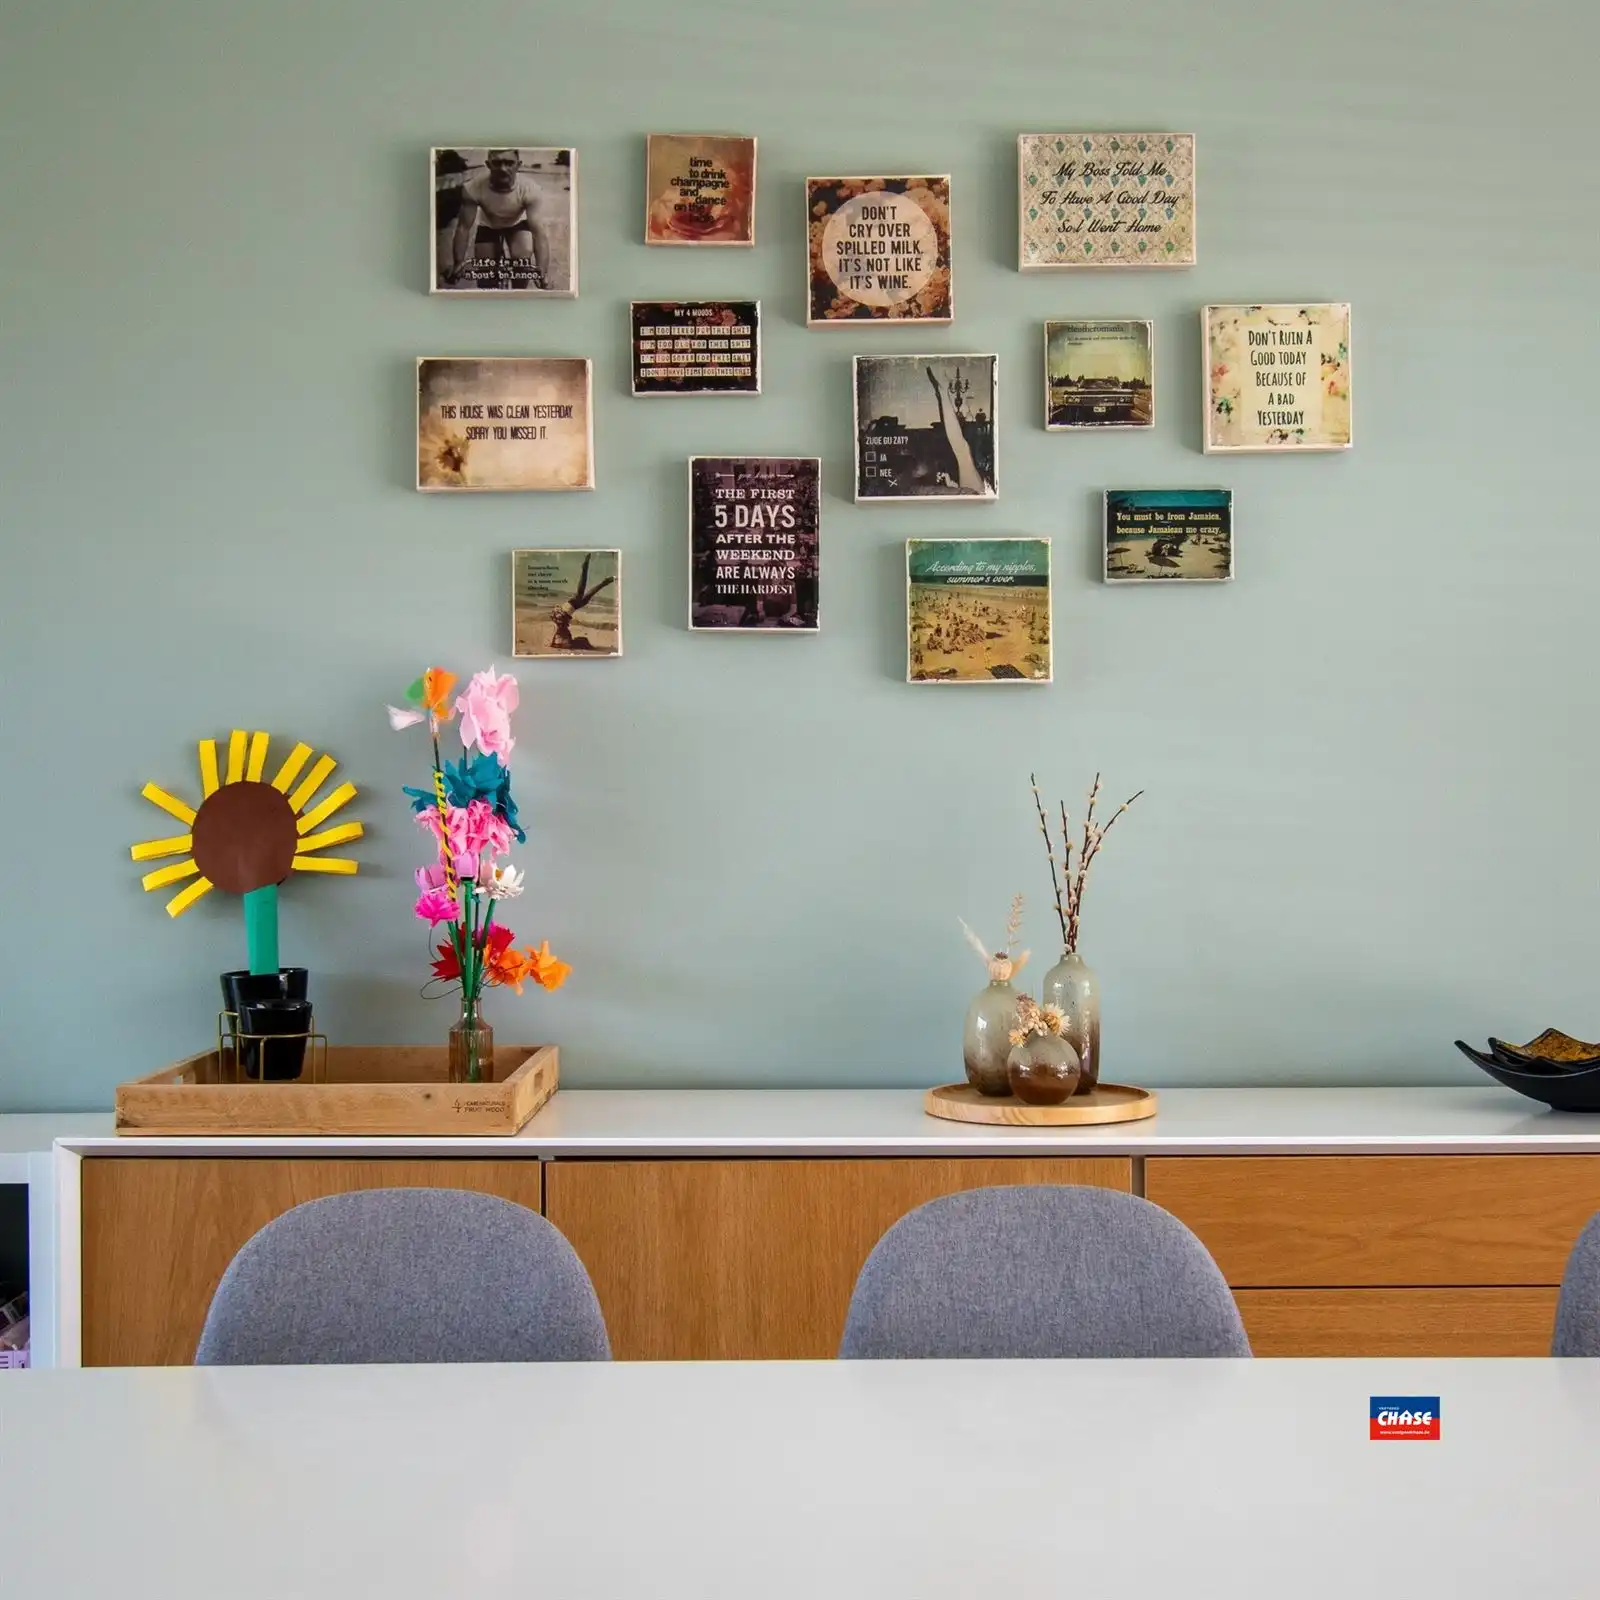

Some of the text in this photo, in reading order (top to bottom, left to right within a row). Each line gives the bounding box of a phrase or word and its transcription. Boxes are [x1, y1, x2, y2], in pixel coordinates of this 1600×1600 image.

[690, 157, 712, 167] time
[689, 169, 726, 179] to drink
[1052, 162, 1167, 180] My Boss Told Me
[671, 177, 729, 189] champagne
[680, 188, 698, 196] and
[695, 195, 726, 205] dance
[1040, 191, 1179, 207] To Have A Good Day
[674, 202, 704, 212] on the
[862, 206, 897, 220] DON'T
[849, 224, 910, 237] CRY OVER
[1088, 220, 1126, 232] Went
[1124, 219, 1161, 232] Home
[836, 241, 924, 255] SPILLED MILK.
[472, 257, 531, 267] Life is all
[839, 258, 921, 272] IT'S NOT LIKE
[850, 275, 911, 289] IT'S WINE.
[656, 326, 670, 335] TOO
[672, 326, 694, 335] TIRED
[696, 326, 710, 335] FOR
[712, 326, 730, 335] THIS
[732, 326, 750, 334] SHIT
[1248, 330, 1312, 346] DON'T RUIN A
[658, 340, 672, 349] TOO
[709, 340, 728, 348] THIS
[731, 340, 750, 348] SHIT
[656, 354, 670, 363] TOO
[696, 354, 710, 362] FOR
[712, 354, 730, 362] THIS
[732, 353, 751, 362] SHIT
[1251, 350, 1306, 365] GOOD TODAY
[641, 368, 645, 377] I
[668, 368, 684, 376] HAVE
[686, 368, 702, 376] TIME
[717, 368, 733, 376] THIS
[734, 367, 751, 376] SHIT
[1256, 371, 1306, 386] BECAUSE OF
[1268, 392, 1294, 405] A BAD
[441, 405, 456, 419] THIS
[460, 406, 484, 419] HOUSE
[487, 406, 503, 419] WAS
[506, 405, 529, 418] CLEAN
[1257, 411, 1304, 425] YESTERDAY
[466, 426, 489, 440] SORRY
[493, 426, 507, 440] YOU
[511, 426, 536, 440] MISSED
[893, 436, 908, 444] ZAT?
[880, 469, 892, 477] NEE
[715, 489, 795, 499] THE FIRST
[715, 505, 795, 527] 5 DAYS
[1167, 512, 1185, 520] from
[1148, 526, 1183, 534] Jamaican
[1200, 527, 1221, 535] crazy.
[716, 534, 795, 544] AFTER THE
[716, 550, 795, 560] WEEKEND
[925, 560, 1036, 574] According to my nipples,
[716, 567, 795, 579] ARE ALWAYS
[947, 574, 990, 583] summer's
[715, 584, 793, 594] THE HARDEST
